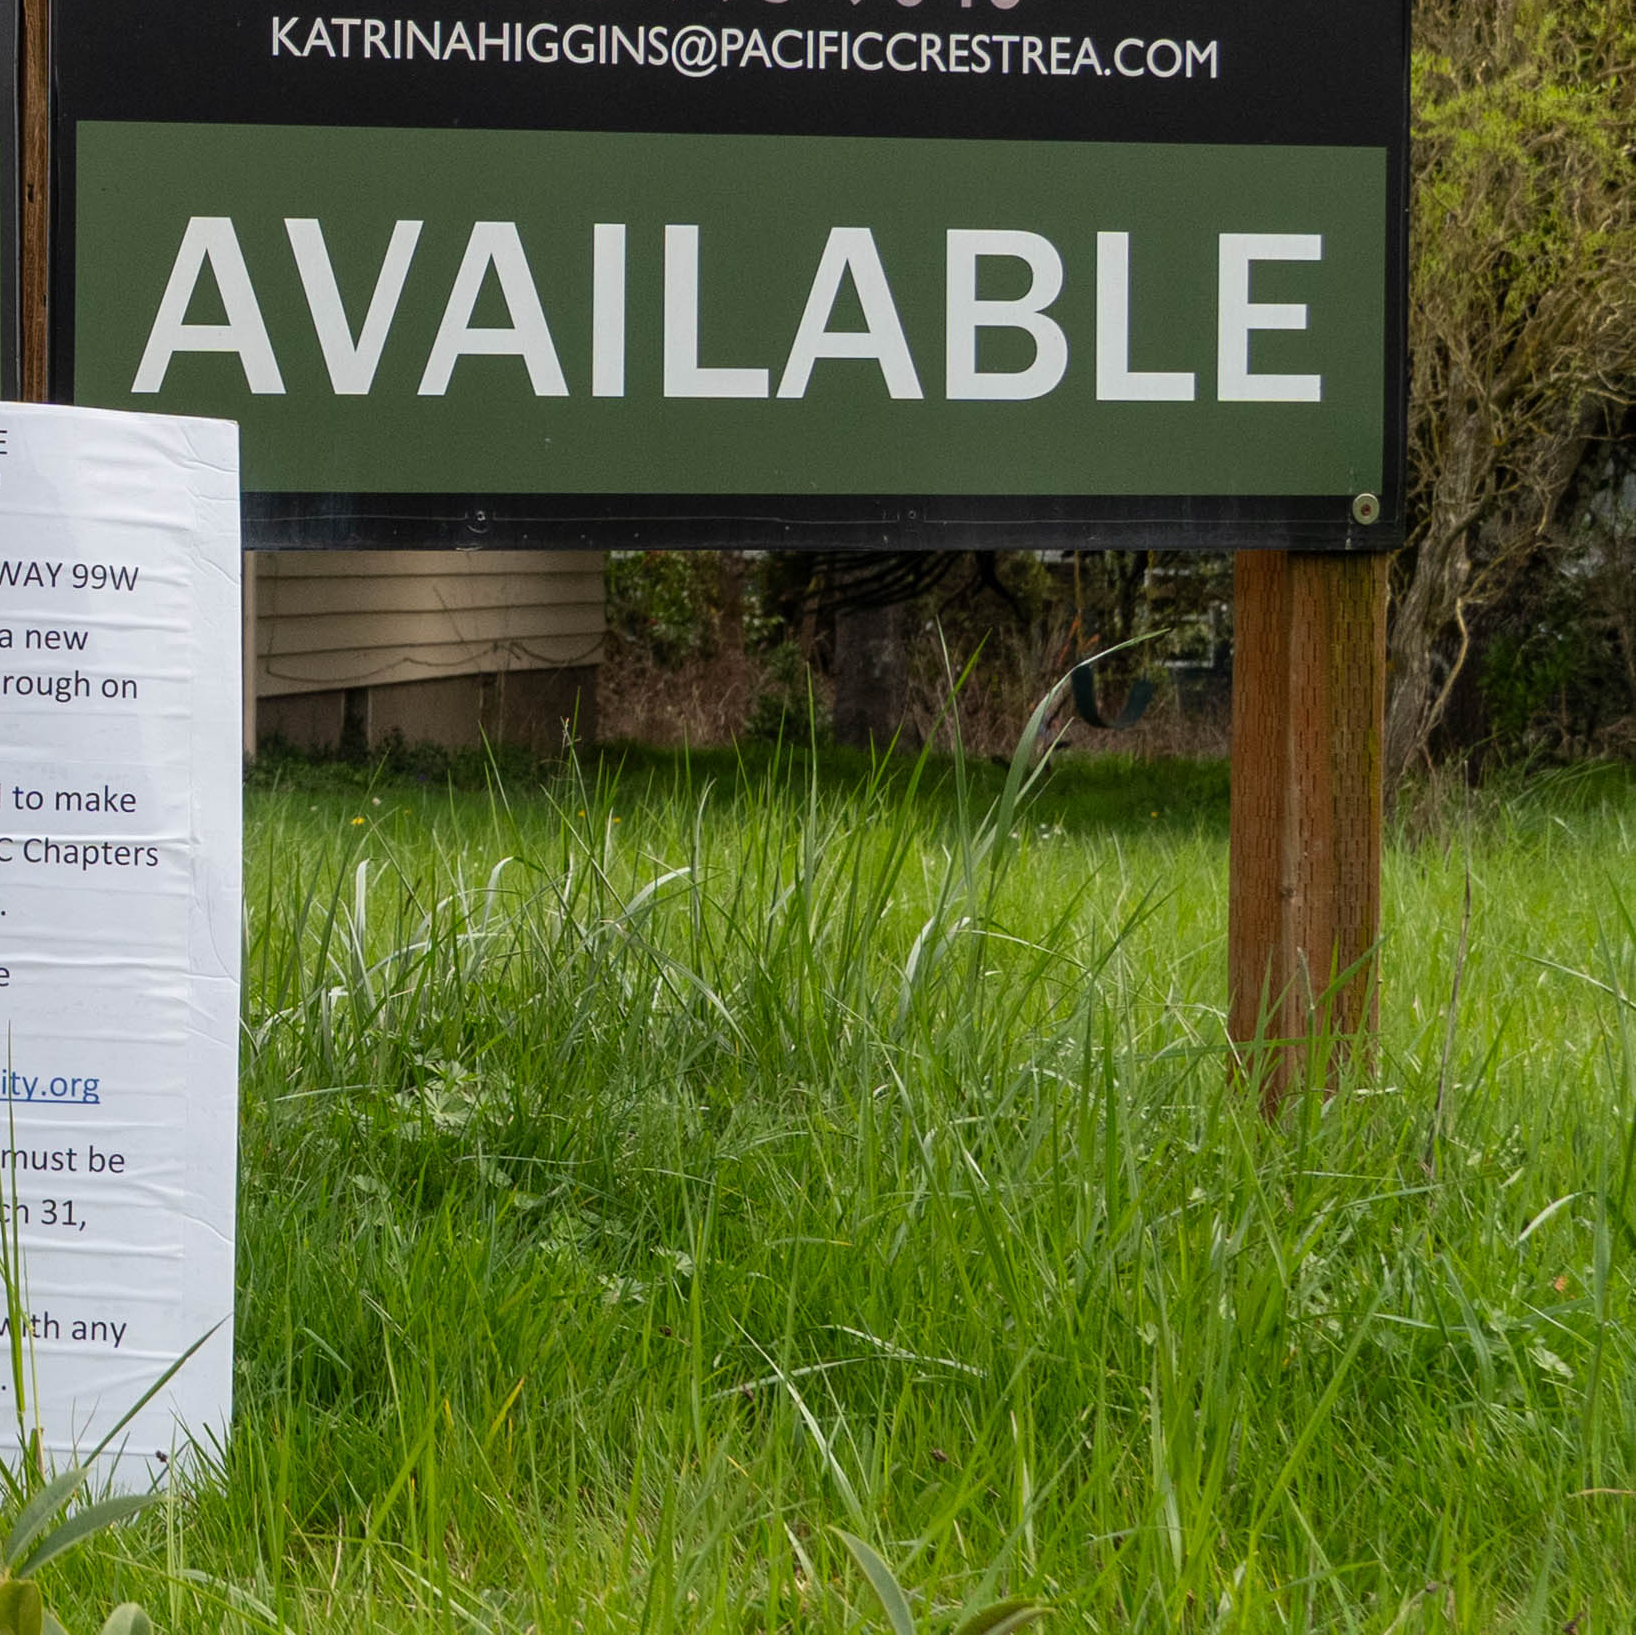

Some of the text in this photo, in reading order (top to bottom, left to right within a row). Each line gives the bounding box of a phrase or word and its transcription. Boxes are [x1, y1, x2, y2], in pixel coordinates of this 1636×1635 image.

[272, 16, 1217, 78] KATRINAHIGGINS@PACIFICCRESTREA.COM
[131, 216, 1322, 402] AVAILABLE
[73, 564, 139, 591] 99W
[26, 630, 88, 650] new
[102, 679, 137, 699] on
[12, 786, 43, 810] to
[56, 785, 136, 813] make
[23, 837, 158, 871] Chapters
[1, 1147, 77, 1172] must
[89, 1145, 125, 1173] be
[41, 1199, 86, 1231] 31,
[72, 1321, 127, 1348] any
